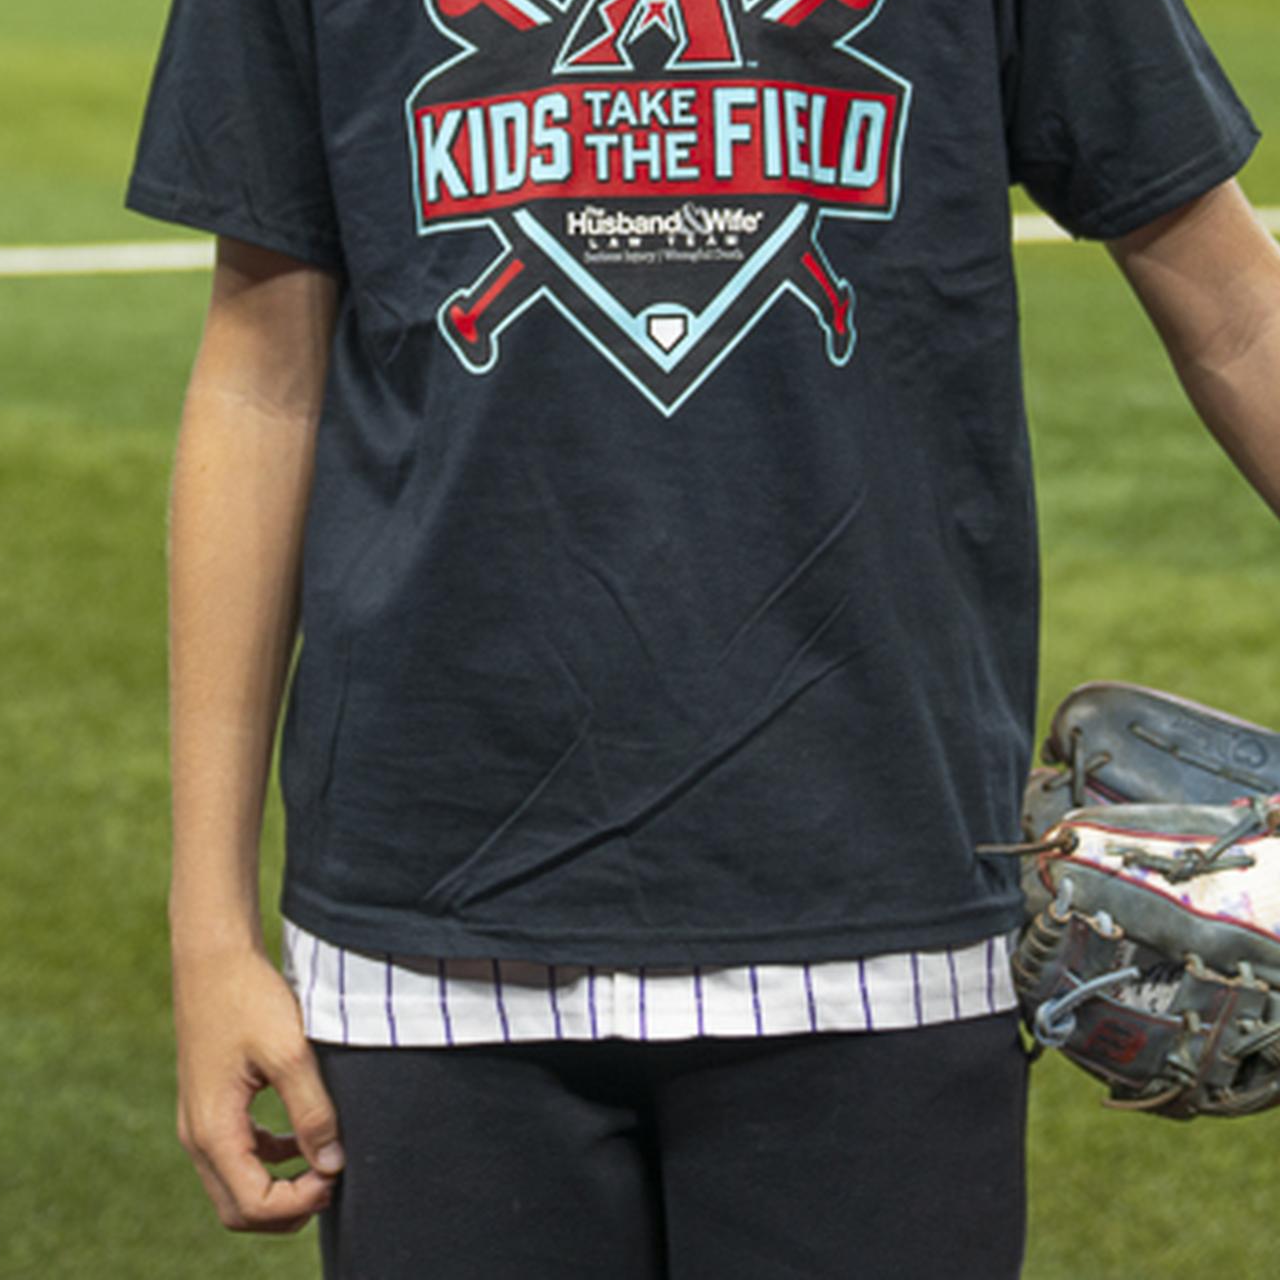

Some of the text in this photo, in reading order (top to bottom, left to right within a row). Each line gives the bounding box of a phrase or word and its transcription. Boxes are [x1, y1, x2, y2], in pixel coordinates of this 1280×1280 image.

[421, 86, 888, 202] KIDS TAKE THE FIELD
